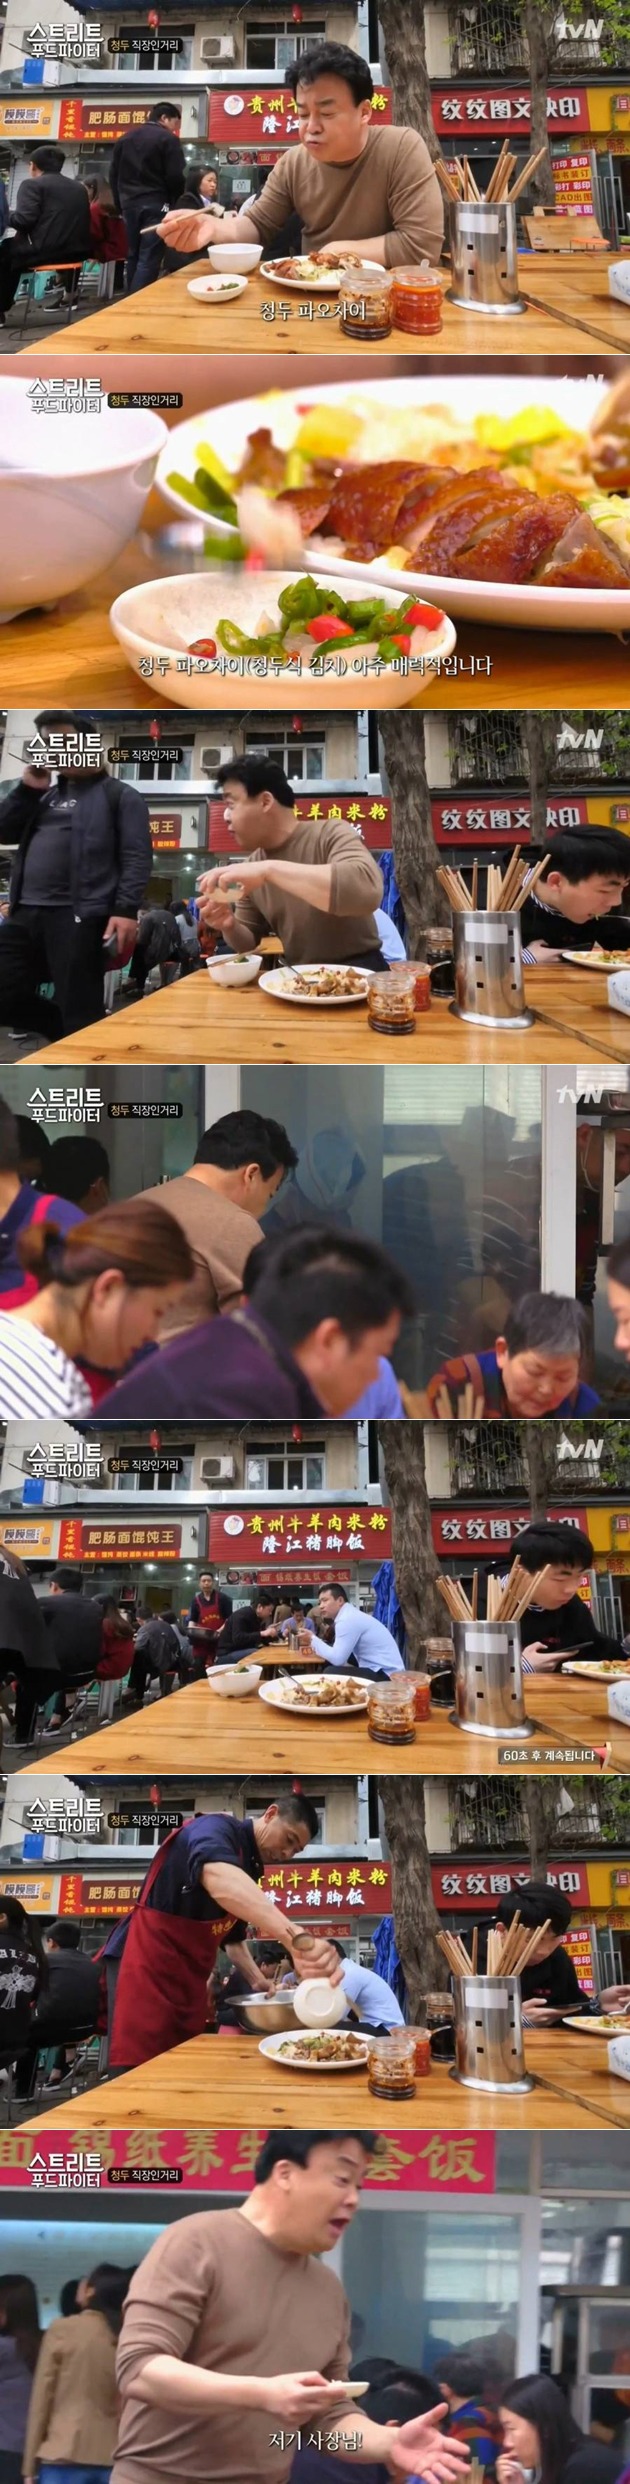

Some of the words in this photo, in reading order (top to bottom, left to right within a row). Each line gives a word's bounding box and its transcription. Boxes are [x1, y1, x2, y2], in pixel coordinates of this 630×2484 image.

[88, 111, 151, 124] 肥肠面馄
[247, 1512, 388, 1534] 贵州牛羊肉米粉
[88, 1531, 174, 1544] 肥肠面馄饨王
[262, 1533, 365, 1553] 隆江猪脚饭
